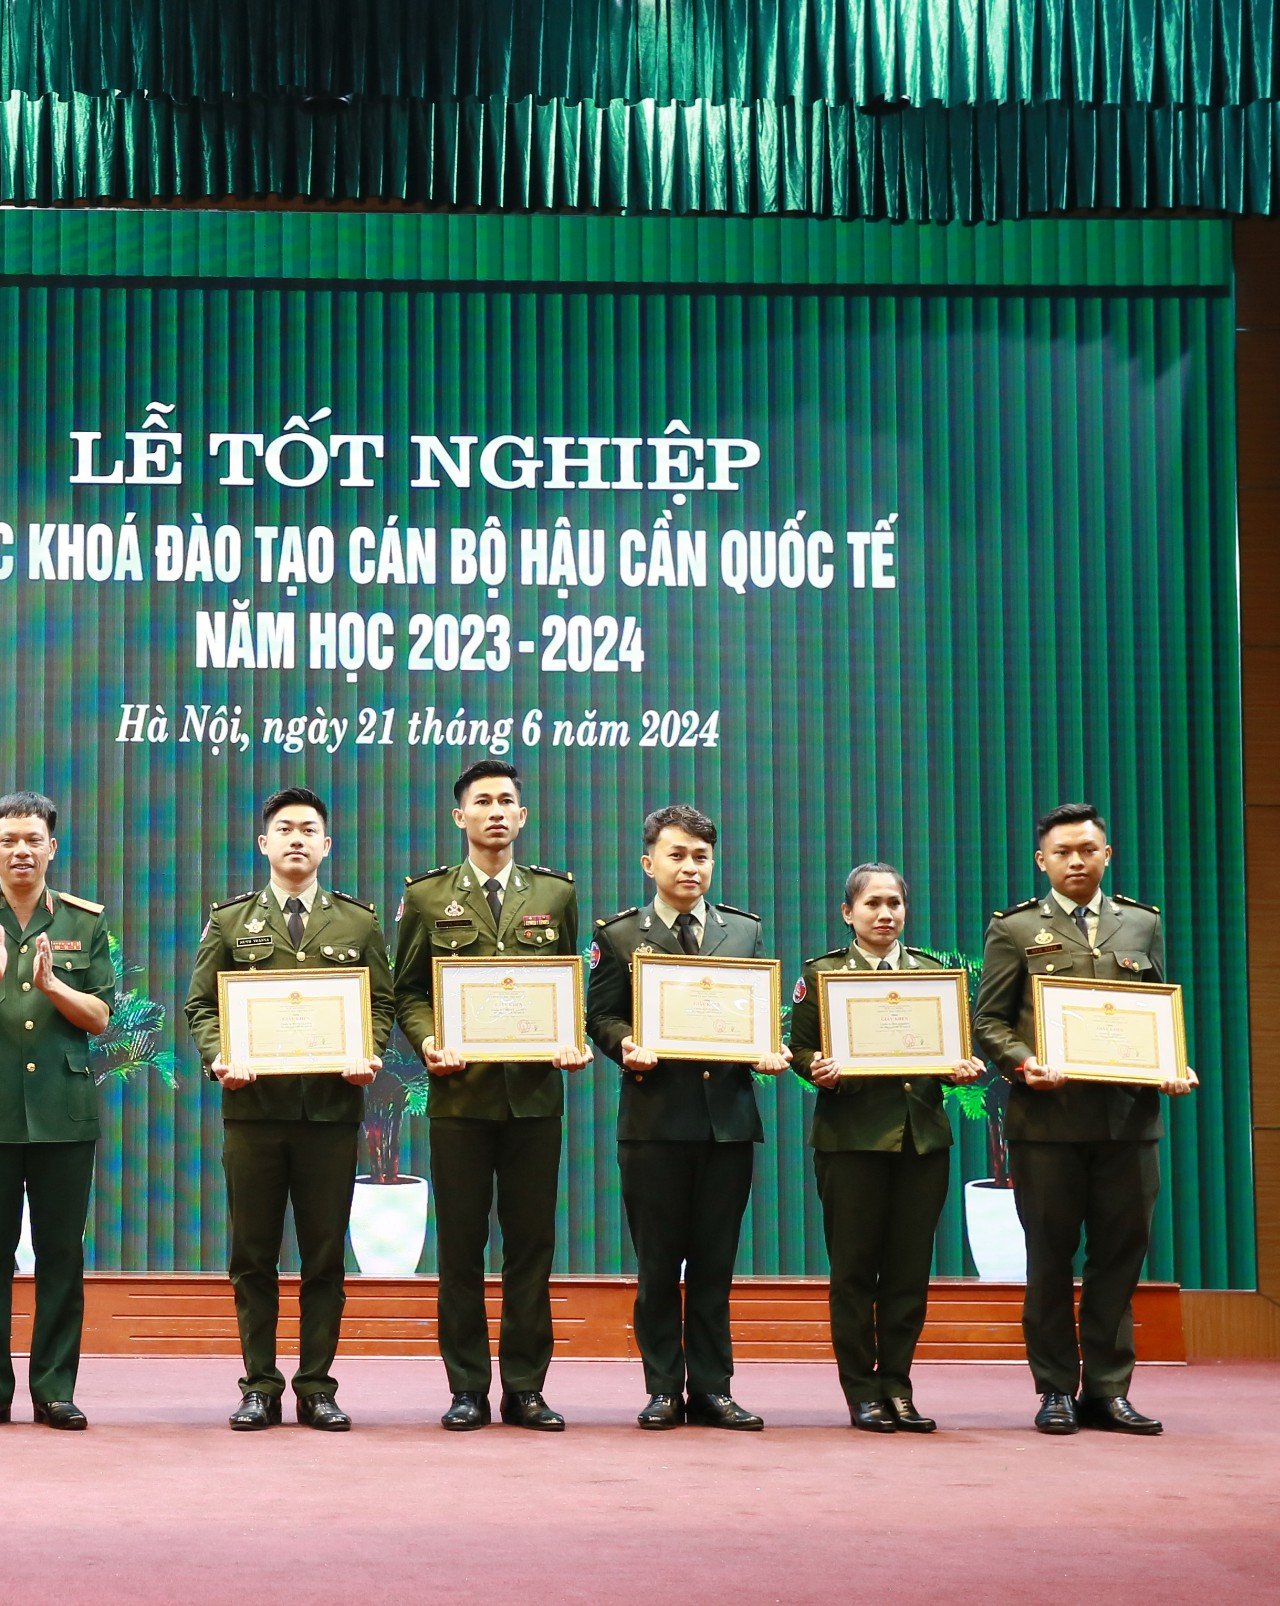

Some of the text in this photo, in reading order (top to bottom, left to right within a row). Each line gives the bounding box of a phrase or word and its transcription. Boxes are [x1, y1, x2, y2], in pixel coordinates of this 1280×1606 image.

[69, 401, 761, 506] LỄ TỐT NGHIỆP
[28, 512, 144, 582] KHOÁ
[154, 512, 242, 583] ĐÀO
[254, 525, 335, 597] TẠO
[349, 514, 437, 585] CÁN
[450, 515, 507, 599] BỘ
[520, 516, 605, 599] HẬU
[619, 509, 707, 588] CẦN
[720, 510, 834, 595] QUỐC
[846, 512, 899, 589] TẾ
[195, 598, 295, 669] NĂM
[309, 611, 395, 683] HỌC
[115, 703, 720, 756] Hà Nội, ngày 21 tháng 6 năm 2024
